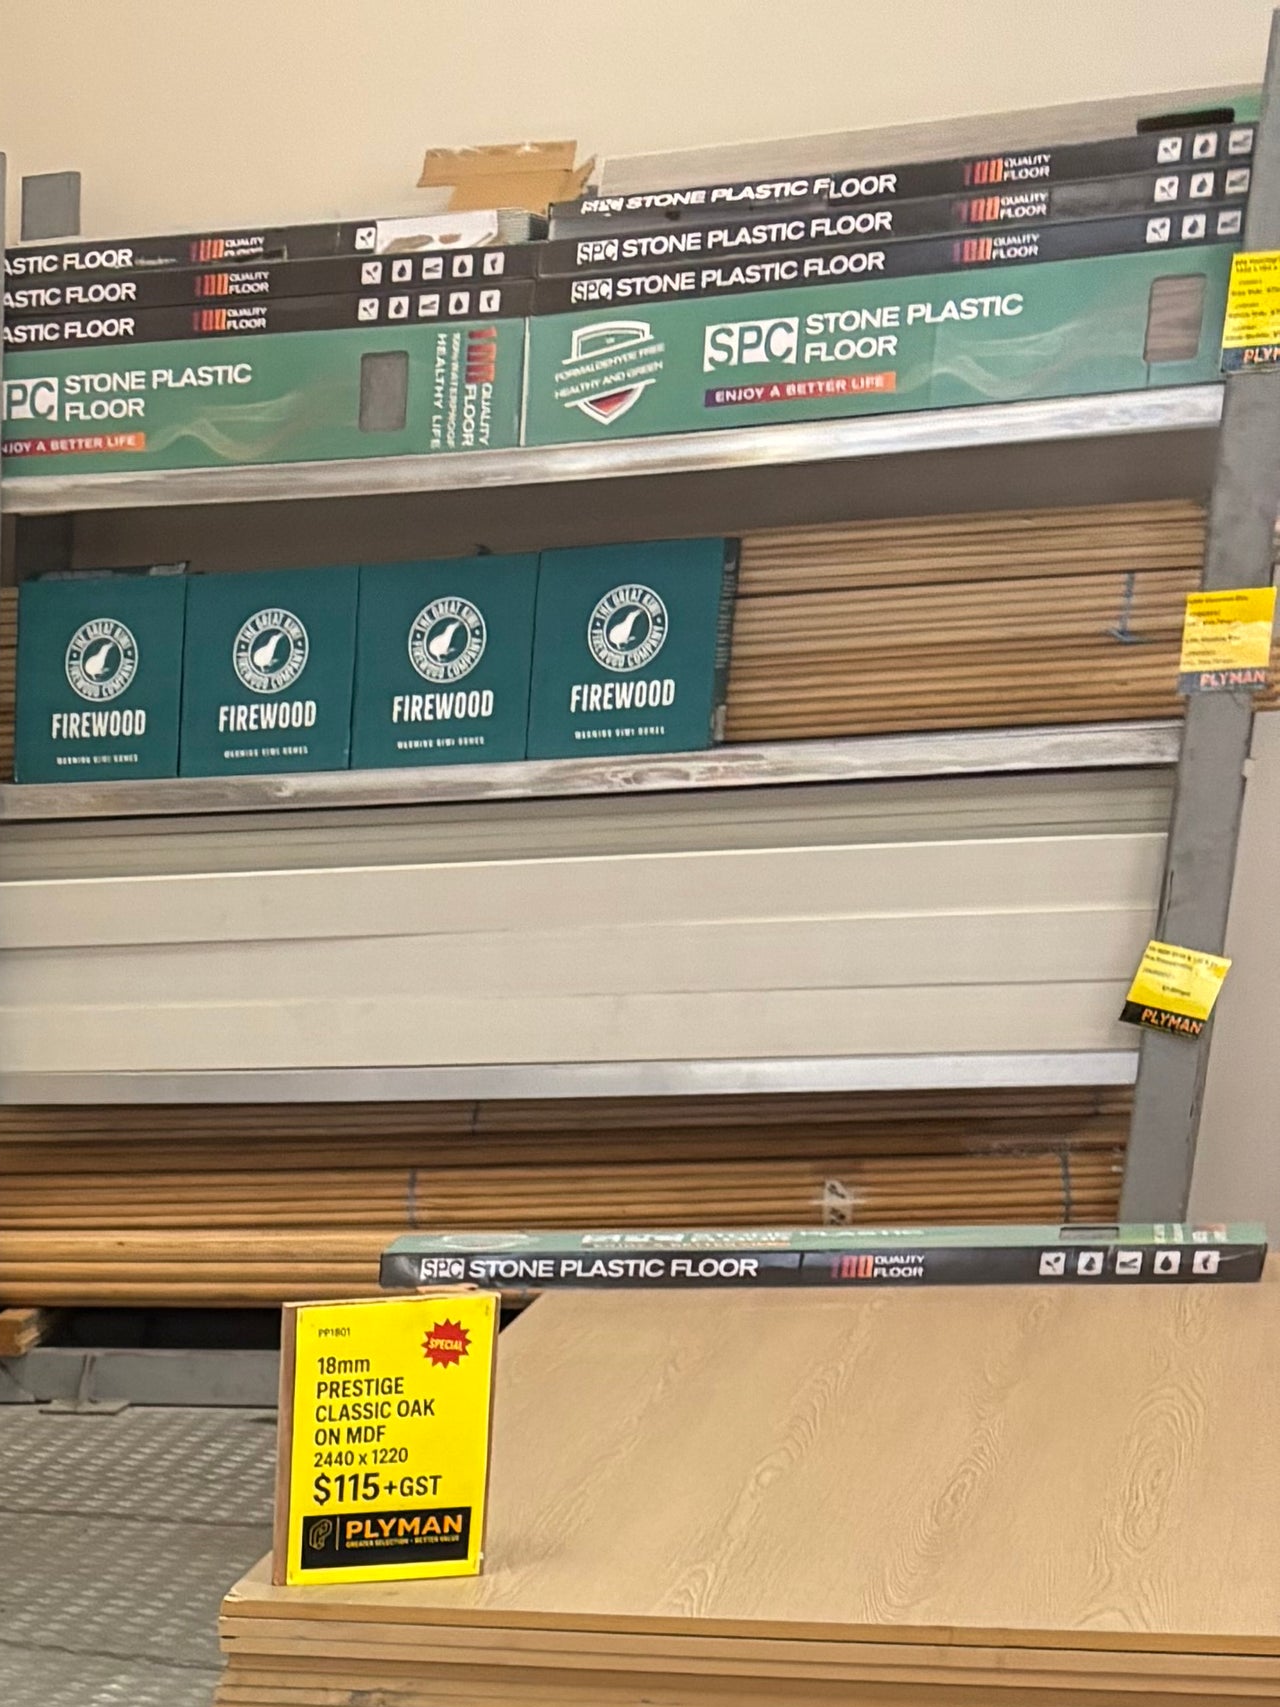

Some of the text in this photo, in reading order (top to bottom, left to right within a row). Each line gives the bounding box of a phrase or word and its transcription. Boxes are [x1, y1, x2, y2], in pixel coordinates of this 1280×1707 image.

[1003, 153, 1052, 182] QUALITY FLOOR
[813, 174, 897, 199] FLOOR
[999, 192, 1049, 220] QUALITY FLOOR
[577, 211, 892, 264] SPC STONE PLASTIC FLOOR
[991, 233, 1040, 260] QUALITY FLOOR
[3, 255, 58, 276] ASTIC
[63, 248, 133, 271] FLOOR
[228, 282, 269, 295] FLOOR
[229, 272, 269, 282] QUALITY
[571, 251, 886, 303] SPC STONE PLASTIC FLOOR
[2, 287, 61, 309] ASTIC
[65, 282, 137, 305] FLOOR
[226, 306, 268, 317] QUALITY
[226, 317, 267, 330] FLOOR
[2, 323, 60, 344] ASTIC
[64, 318, 135, 339] FLOOR
[703, 293, 1024, 372] SPC STONE PLASTIC
[804, 335, 898, 364] FLOOR
[3, 363, 252, 422] PC STONE PLASTIC
[714, 375, 885, 403] ENJOY A BETTER LIFE
[65, 398, 145, 422] FLOOR
[462, 384, 477, 446] FLOOR
[2, 435, 137, 454] NJOY A BETTER LIFE
[1200, 670, 1266, 687] PLYMAN
[392, 690, 494, 724] FIREWOOD
[570, 679, 676, 713] FIREWOOD
[52, 709, 147, 740] FIREWOOD
[218, 700, 317, 732] FIREWOOD
[1141, 1008, 1203, 1034] PLYMAN
[419, 1257, 758, 1280] SPC STONE PLASTIC FLOOR
[873, 1254, 926, 1278] QUALITY FLOOR
[428, 1338, 463, 1351] SPECIAL
[317, 1357, 370, 1375] 18mm
[316, 1377, 405, 1399] PRESTIGE
[315, 1398, 435, 1423] CLASSIC OAK
[314, 1425, 386, 1446] ON MDF
[313, 1448, 409, 1468] 2440 x 1220
[345, 1514, 463, 1540] PLYMAN
